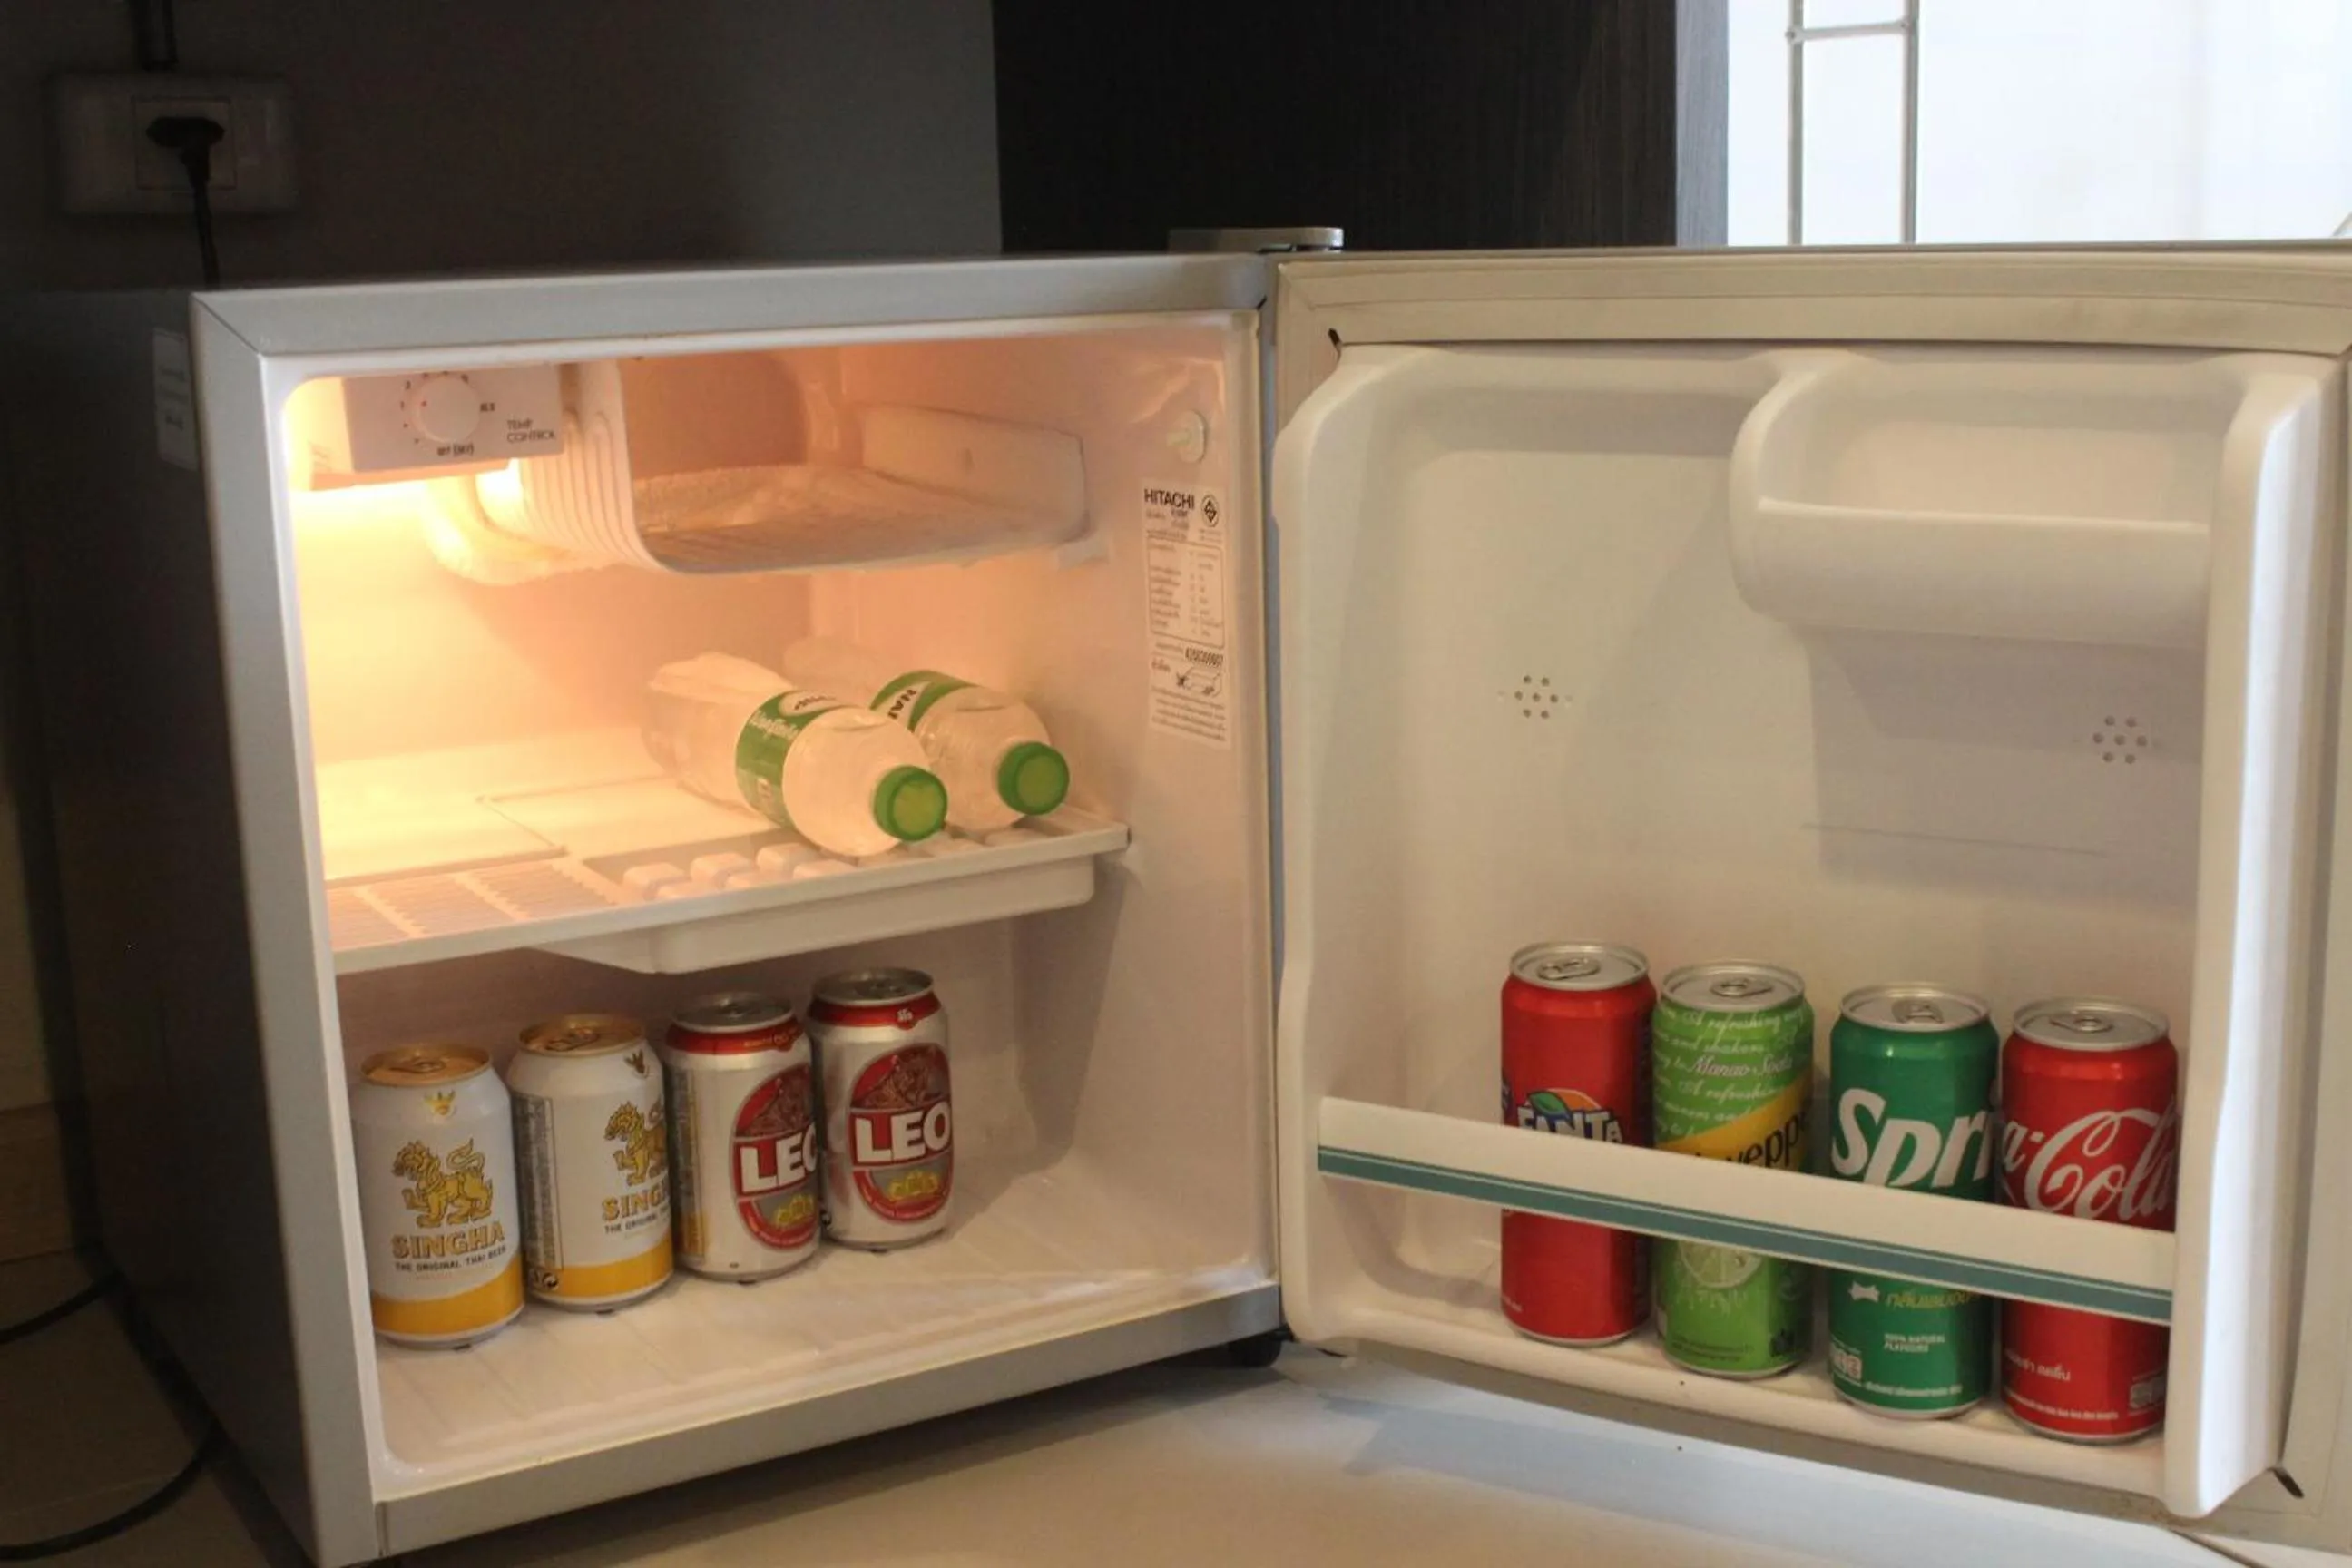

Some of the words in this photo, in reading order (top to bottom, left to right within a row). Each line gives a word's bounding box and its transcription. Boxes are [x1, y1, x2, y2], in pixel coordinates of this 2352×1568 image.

[506, 428, 556, 444] CONTROL
[1143, 488, 1195, 510] HITACHI
[856, 1102, 950, 1162] LEO
[391, 1221, 505, 1259] SINGHA
[395, 1261, 412, 1272] THE
[416, 1259, 461, 1272] ORIGINAL
[466, 1253, 485, 1266] THAI
